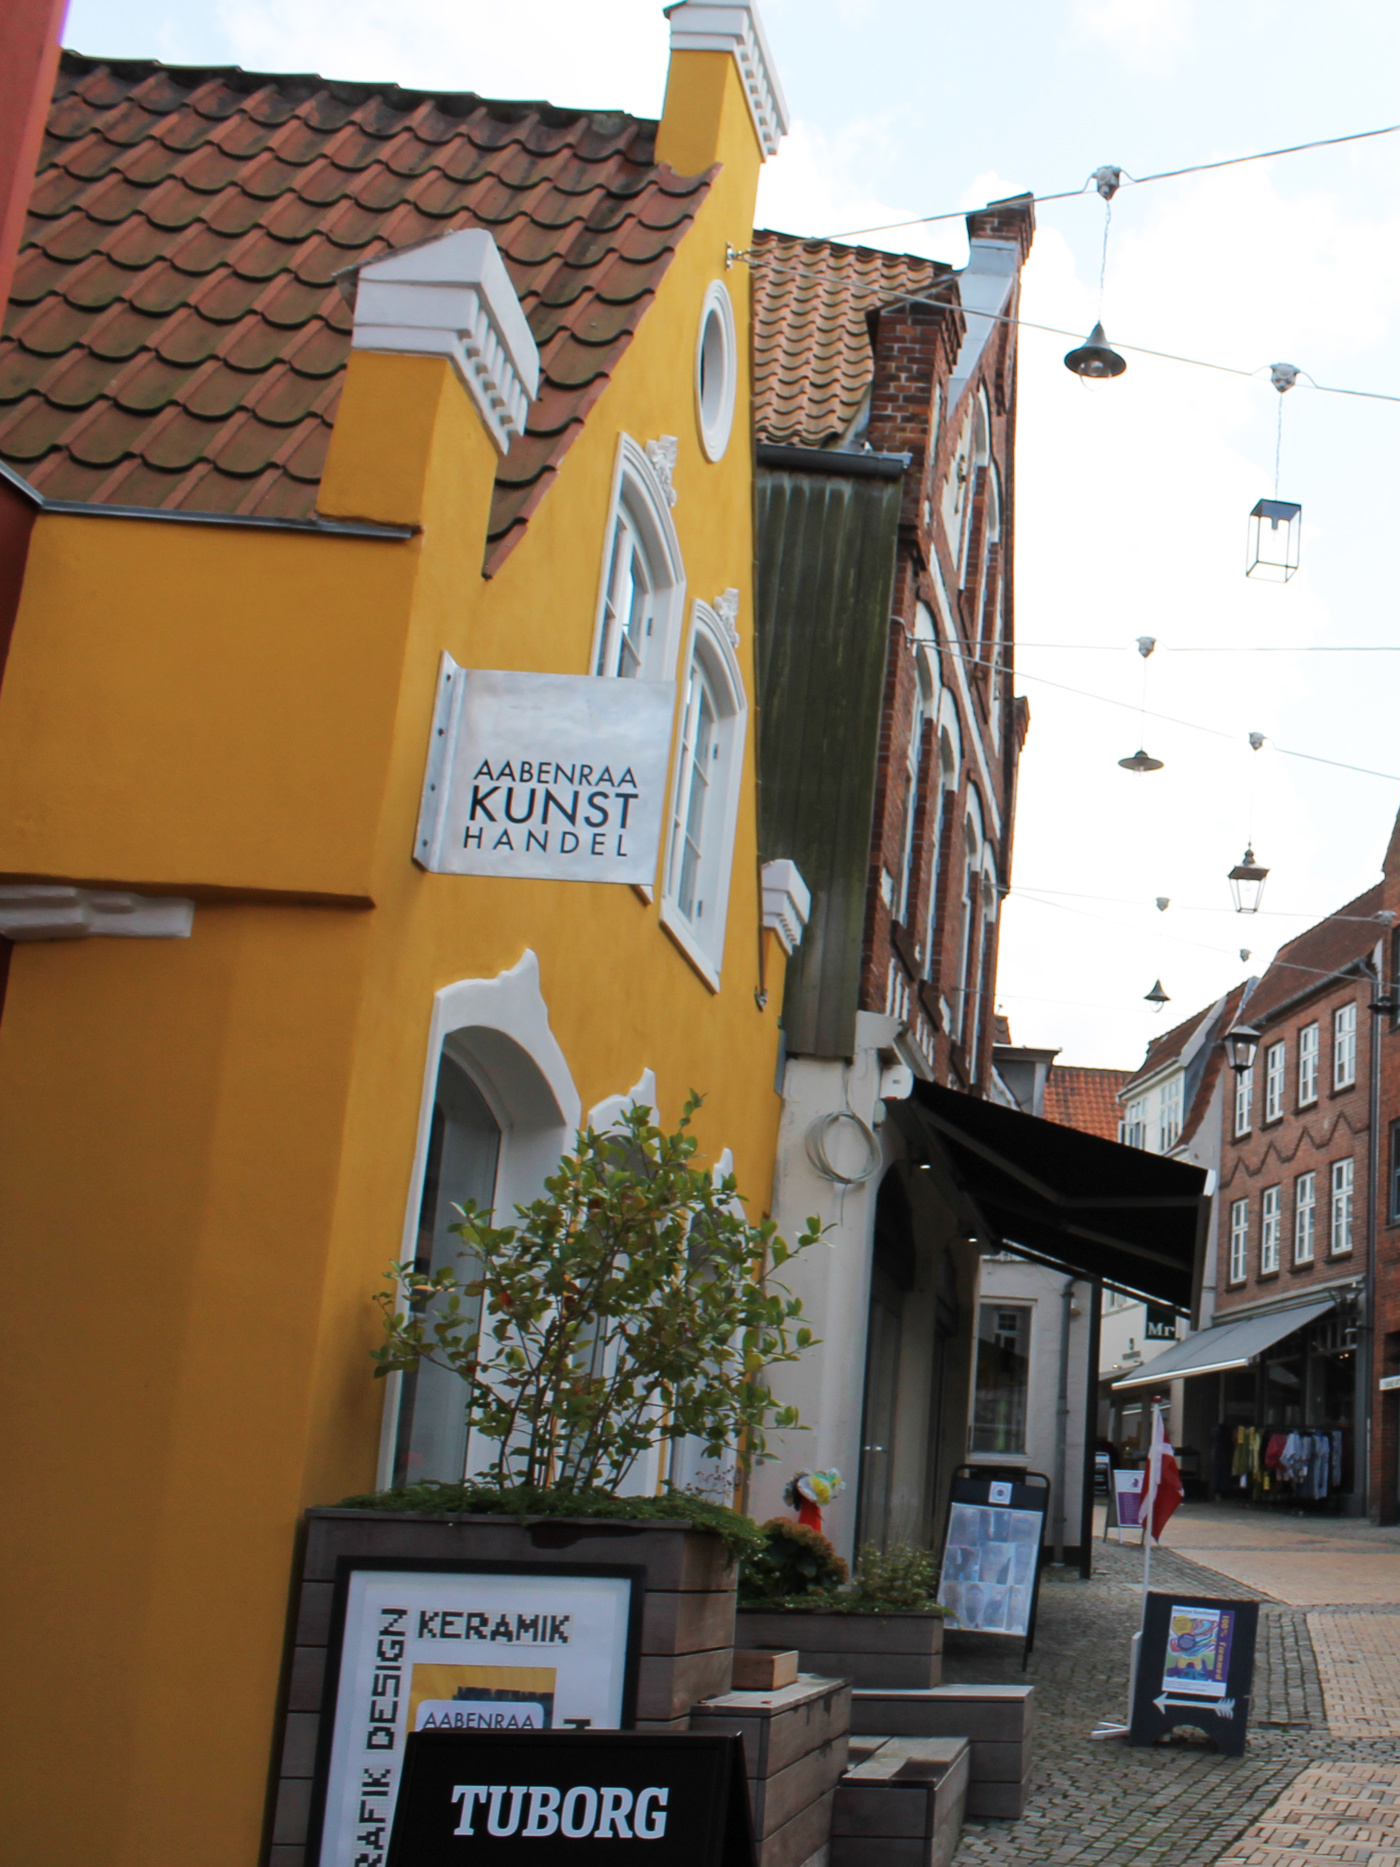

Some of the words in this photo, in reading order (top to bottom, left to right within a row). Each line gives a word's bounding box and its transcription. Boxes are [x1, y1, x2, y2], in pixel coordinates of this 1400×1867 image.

[473, 759, 638, 788] AABENRAA
[469, 785, 639, 829] KUNST
[463, 826, 628, 856] HANDEL
[417, 1609, 571, 1644] KERAMIK
[366, 1608, 408, 1751] DESIGN
[422, 1711, 535, 1729] AABENRAA
[354, 1768, 392, 1867] RAFIK
[451, 1785, 669, 1840] TUBORG
